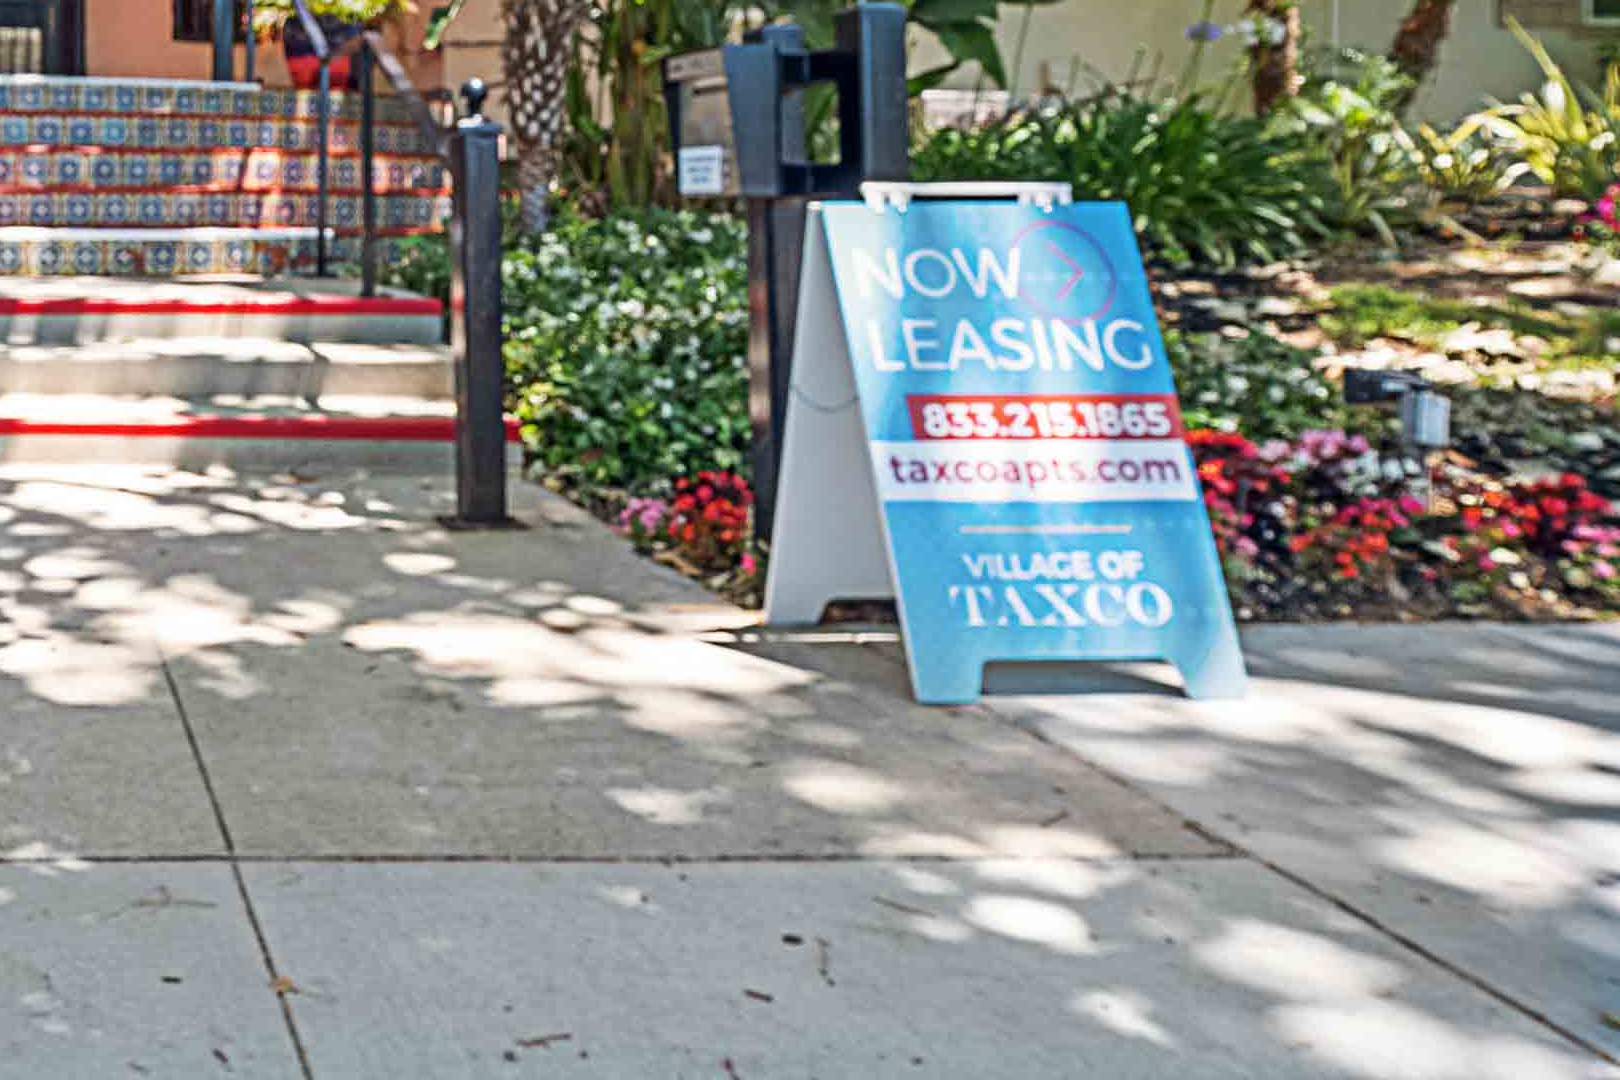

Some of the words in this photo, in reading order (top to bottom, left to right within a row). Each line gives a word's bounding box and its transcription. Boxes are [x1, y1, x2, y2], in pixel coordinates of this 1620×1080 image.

[852, 247, 1021, 299] NOW
[867, 317, 1154, 372] LEASING
[921, 401, 1171, 438] 833.215.1865
[890, 456, 1180, 488] taxcoapts.com
[959, 550, 1095, 580] VILLAGE
[1097, 550, 1145, 579] OF
[948, 582, 1174, 627] TAXCO
